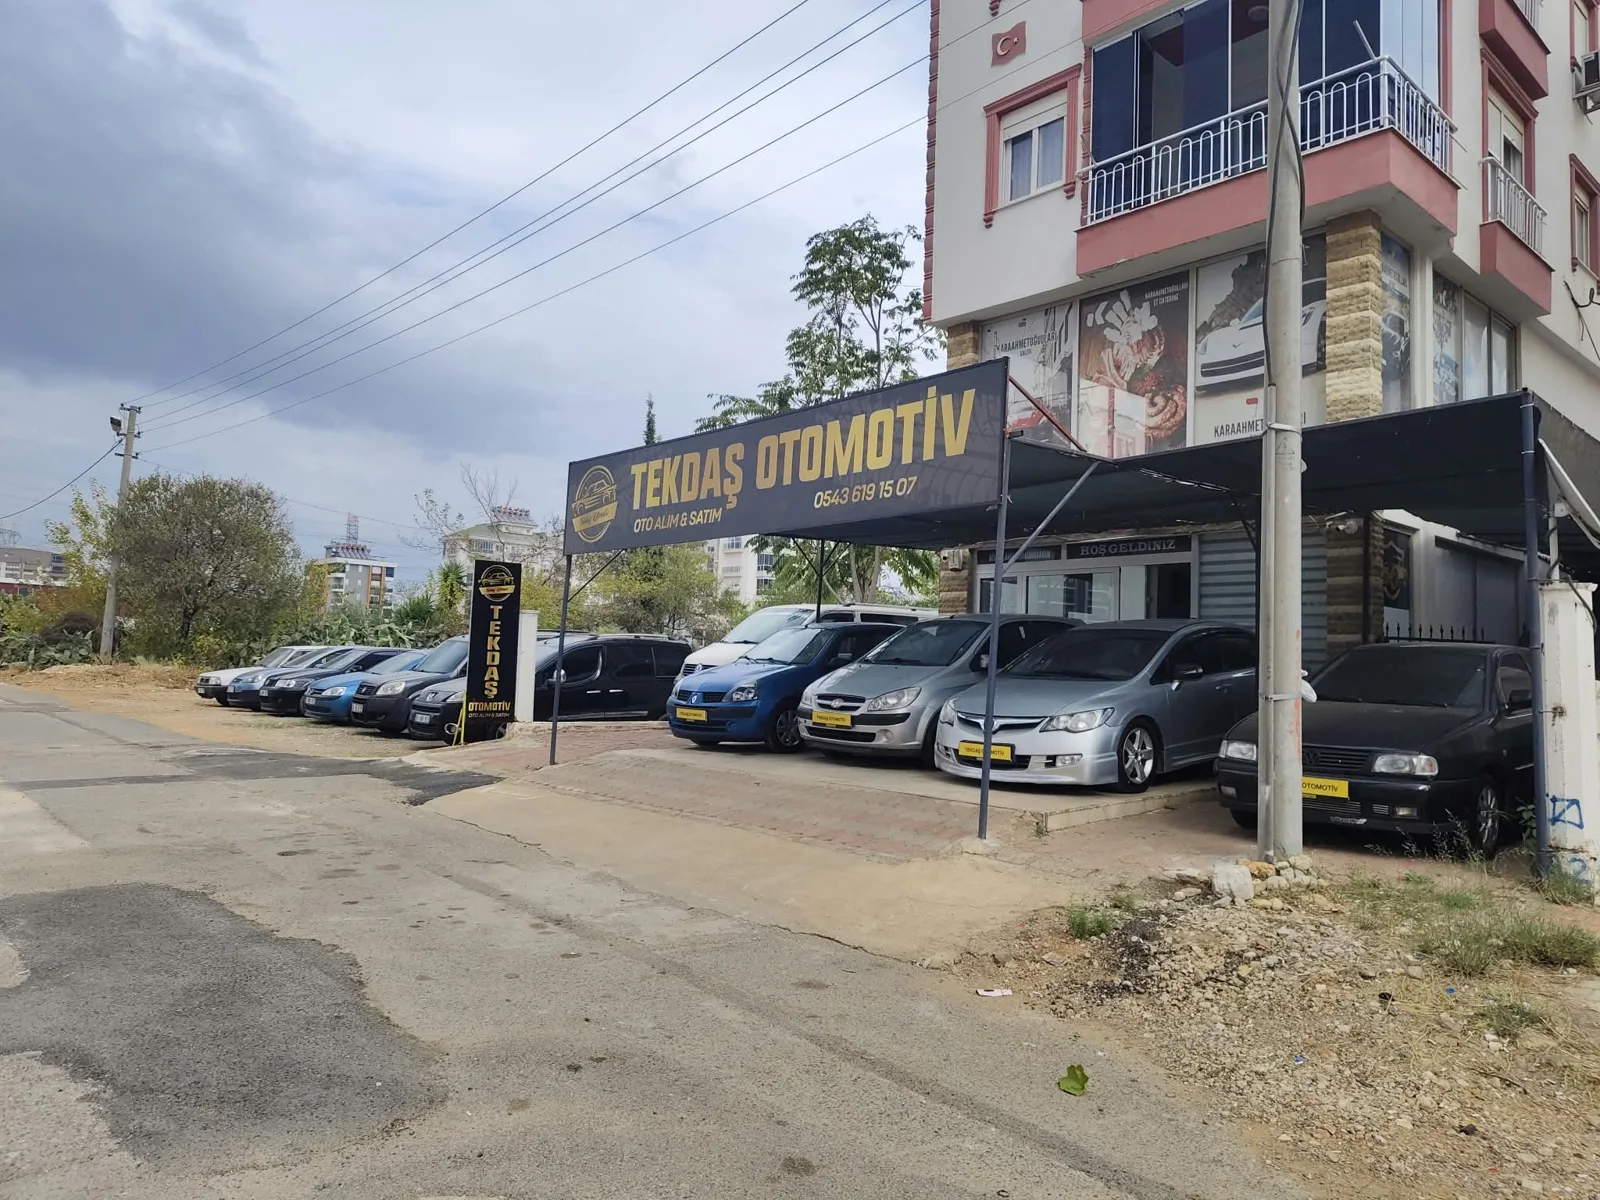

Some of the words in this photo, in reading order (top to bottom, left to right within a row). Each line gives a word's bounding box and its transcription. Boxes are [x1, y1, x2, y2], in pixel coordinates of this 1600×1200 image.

[631, 443, 744, 509] TEKDAŞ
[756, 385, 975, 489] OTOMOTİV
[813, 486, 850, 508] 0543
[851, 483, 876, 502] 619
[879, 480, 895, 498] 15
[895, 476, 918, 496] 07
[633, 517, 653, 533] OTO
[653, 512, 679, 530] ALIM
[680, 512, 687, 527] &
[689, 507, 723, 526] SATIM
[484, 605, 503, 699] TEKDAŞ
[468, 701, 511, 711] OTOMOTİV
[1302, 782, 1339, 792] OTOMOTİV
